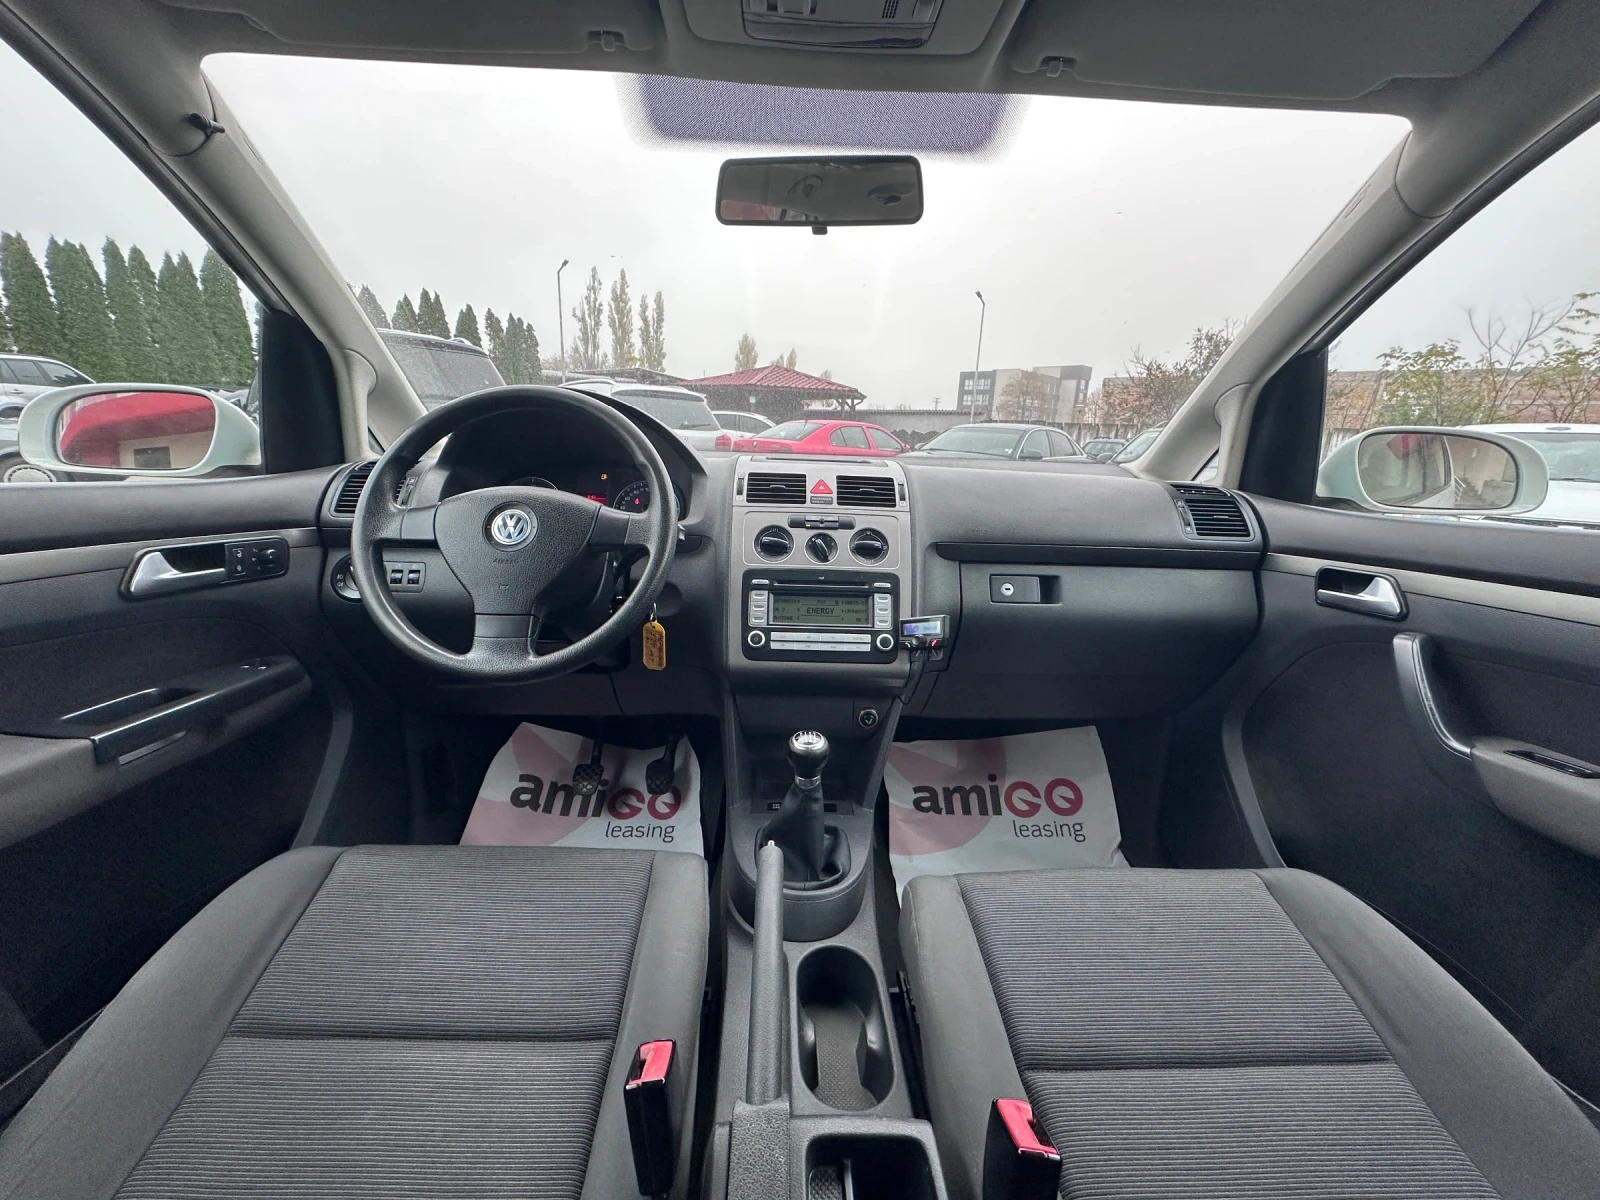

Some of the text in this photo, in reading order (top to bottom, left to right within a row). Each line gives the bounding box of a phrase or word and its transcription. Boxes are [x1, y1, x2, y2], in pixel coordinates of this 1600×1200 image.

[806, 607, 835, 615] ENERGY
[605, 821, 676, 843] leasing
[1012, 820, 1086, 843] leasing
